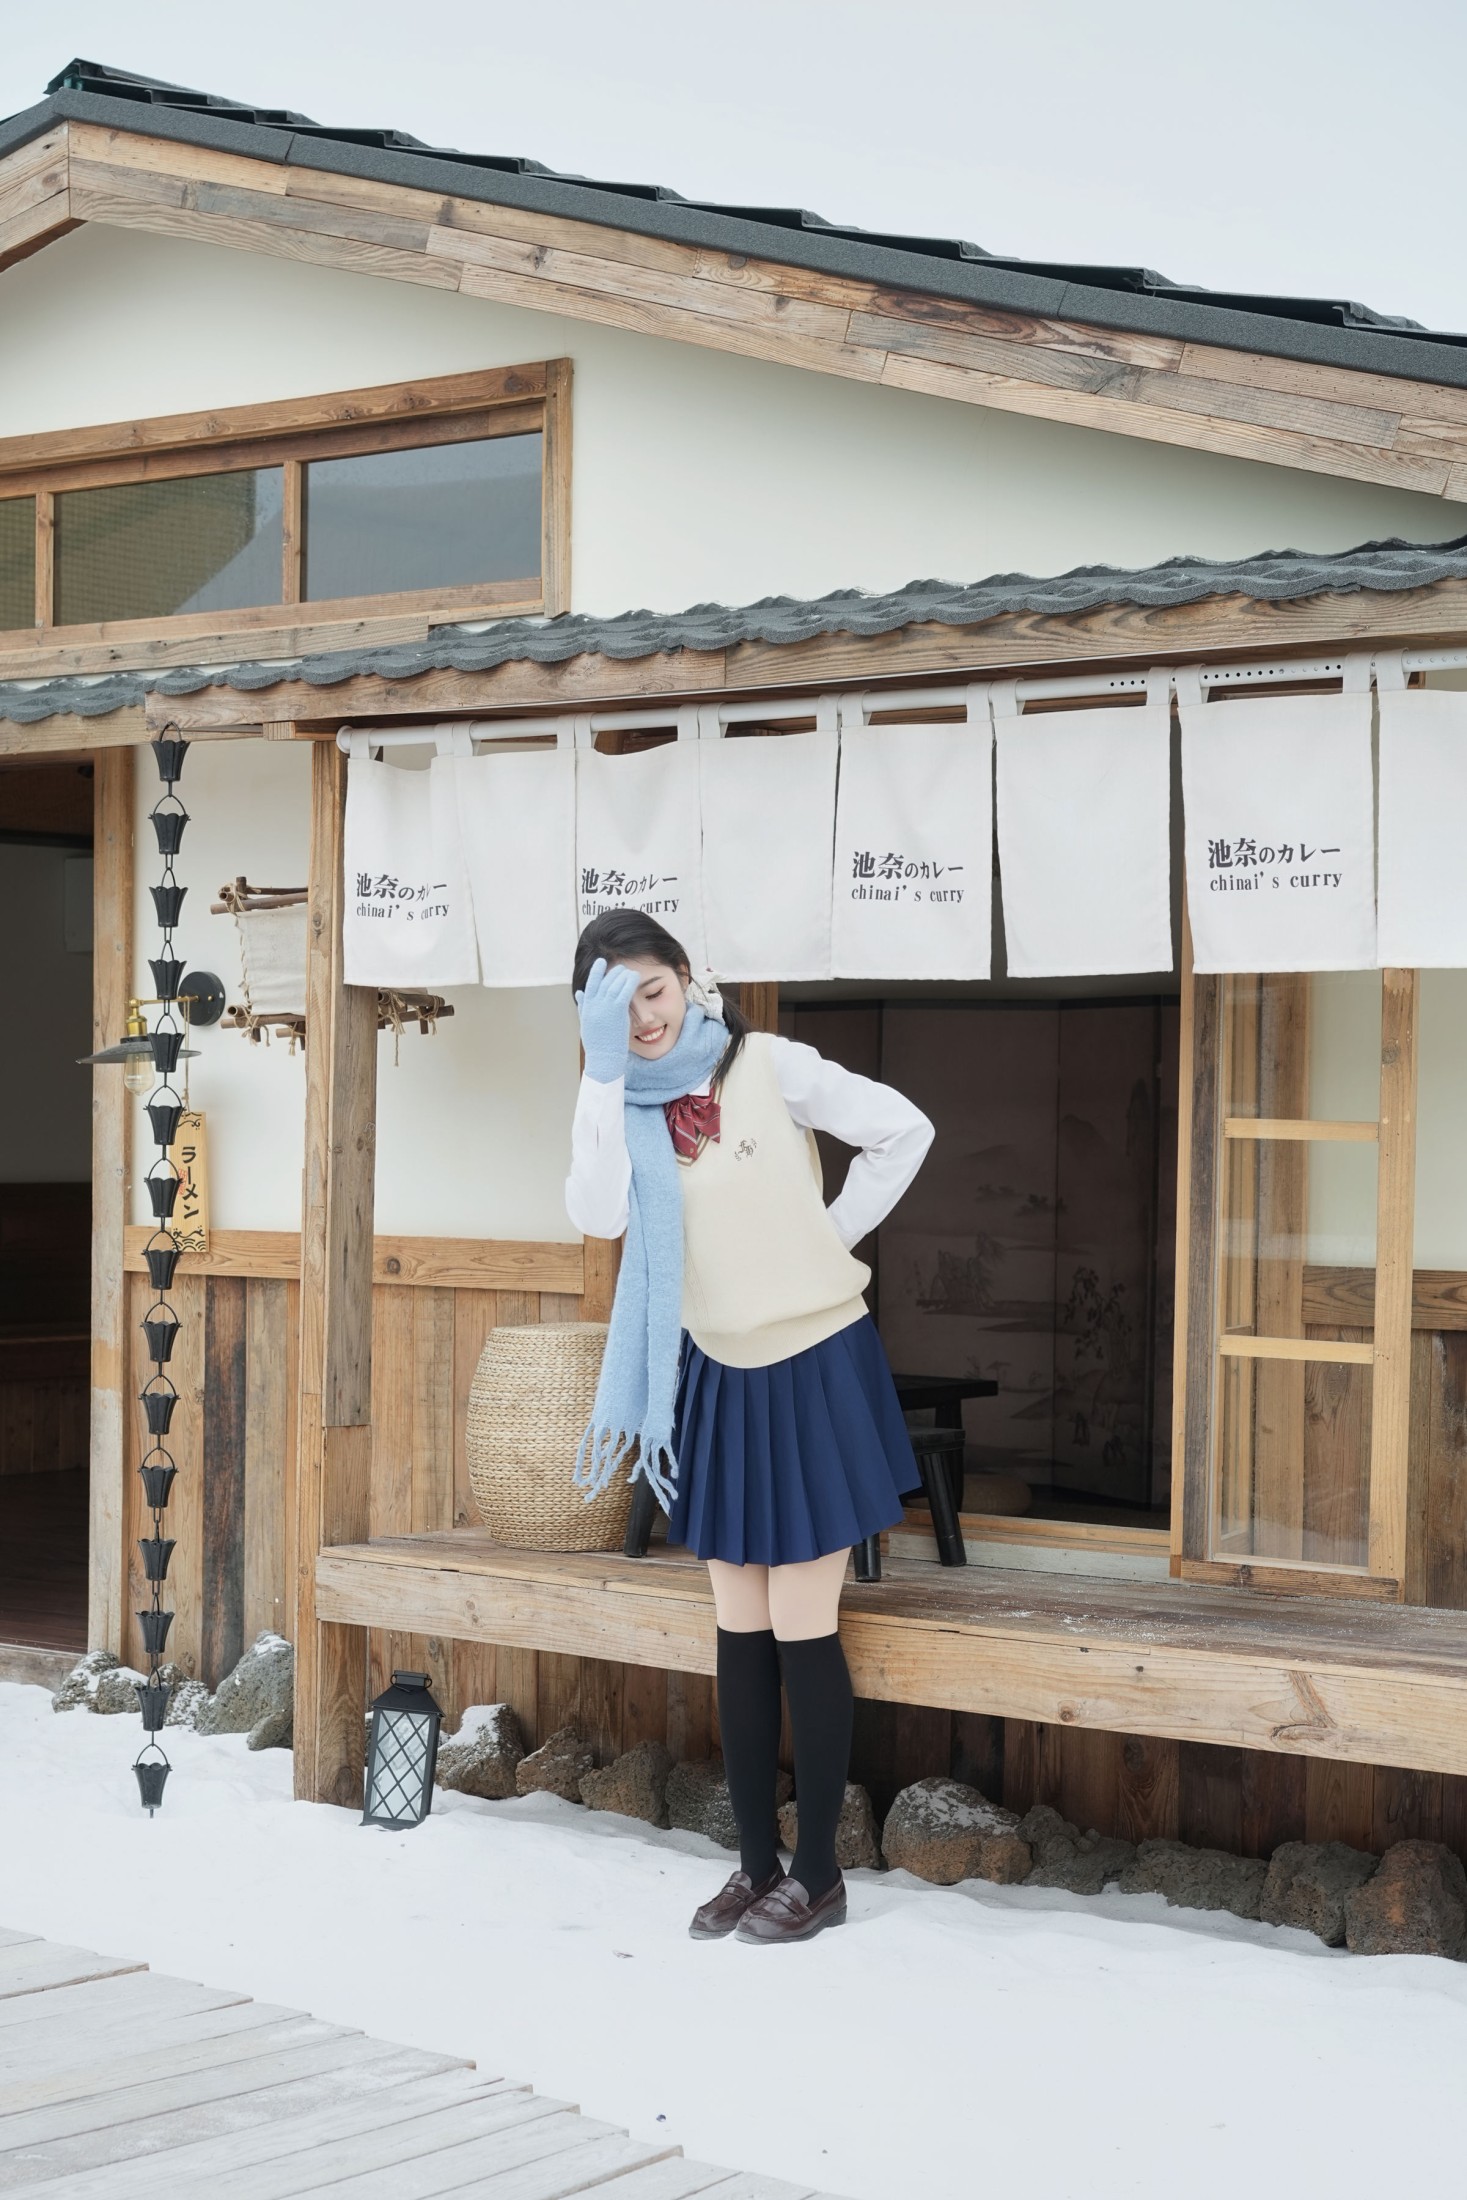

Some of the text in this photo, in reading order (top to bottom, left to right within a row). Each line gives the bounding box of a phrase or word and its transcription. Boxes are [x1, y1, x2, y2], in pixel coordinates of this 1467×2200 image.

[852, 851, 964, 879] 池奈のカレー
[1208, 838, 1341, 869] 池奈のカレー
[357, 872, 447, 902] 池奈のカレー
[581, 868, 678, 896] 池奈のカレー
[1290, 873, 1342, 888] curry
[930, 889, 965, 903] curry
[182, 1146, 199, 1219] ラーメン
